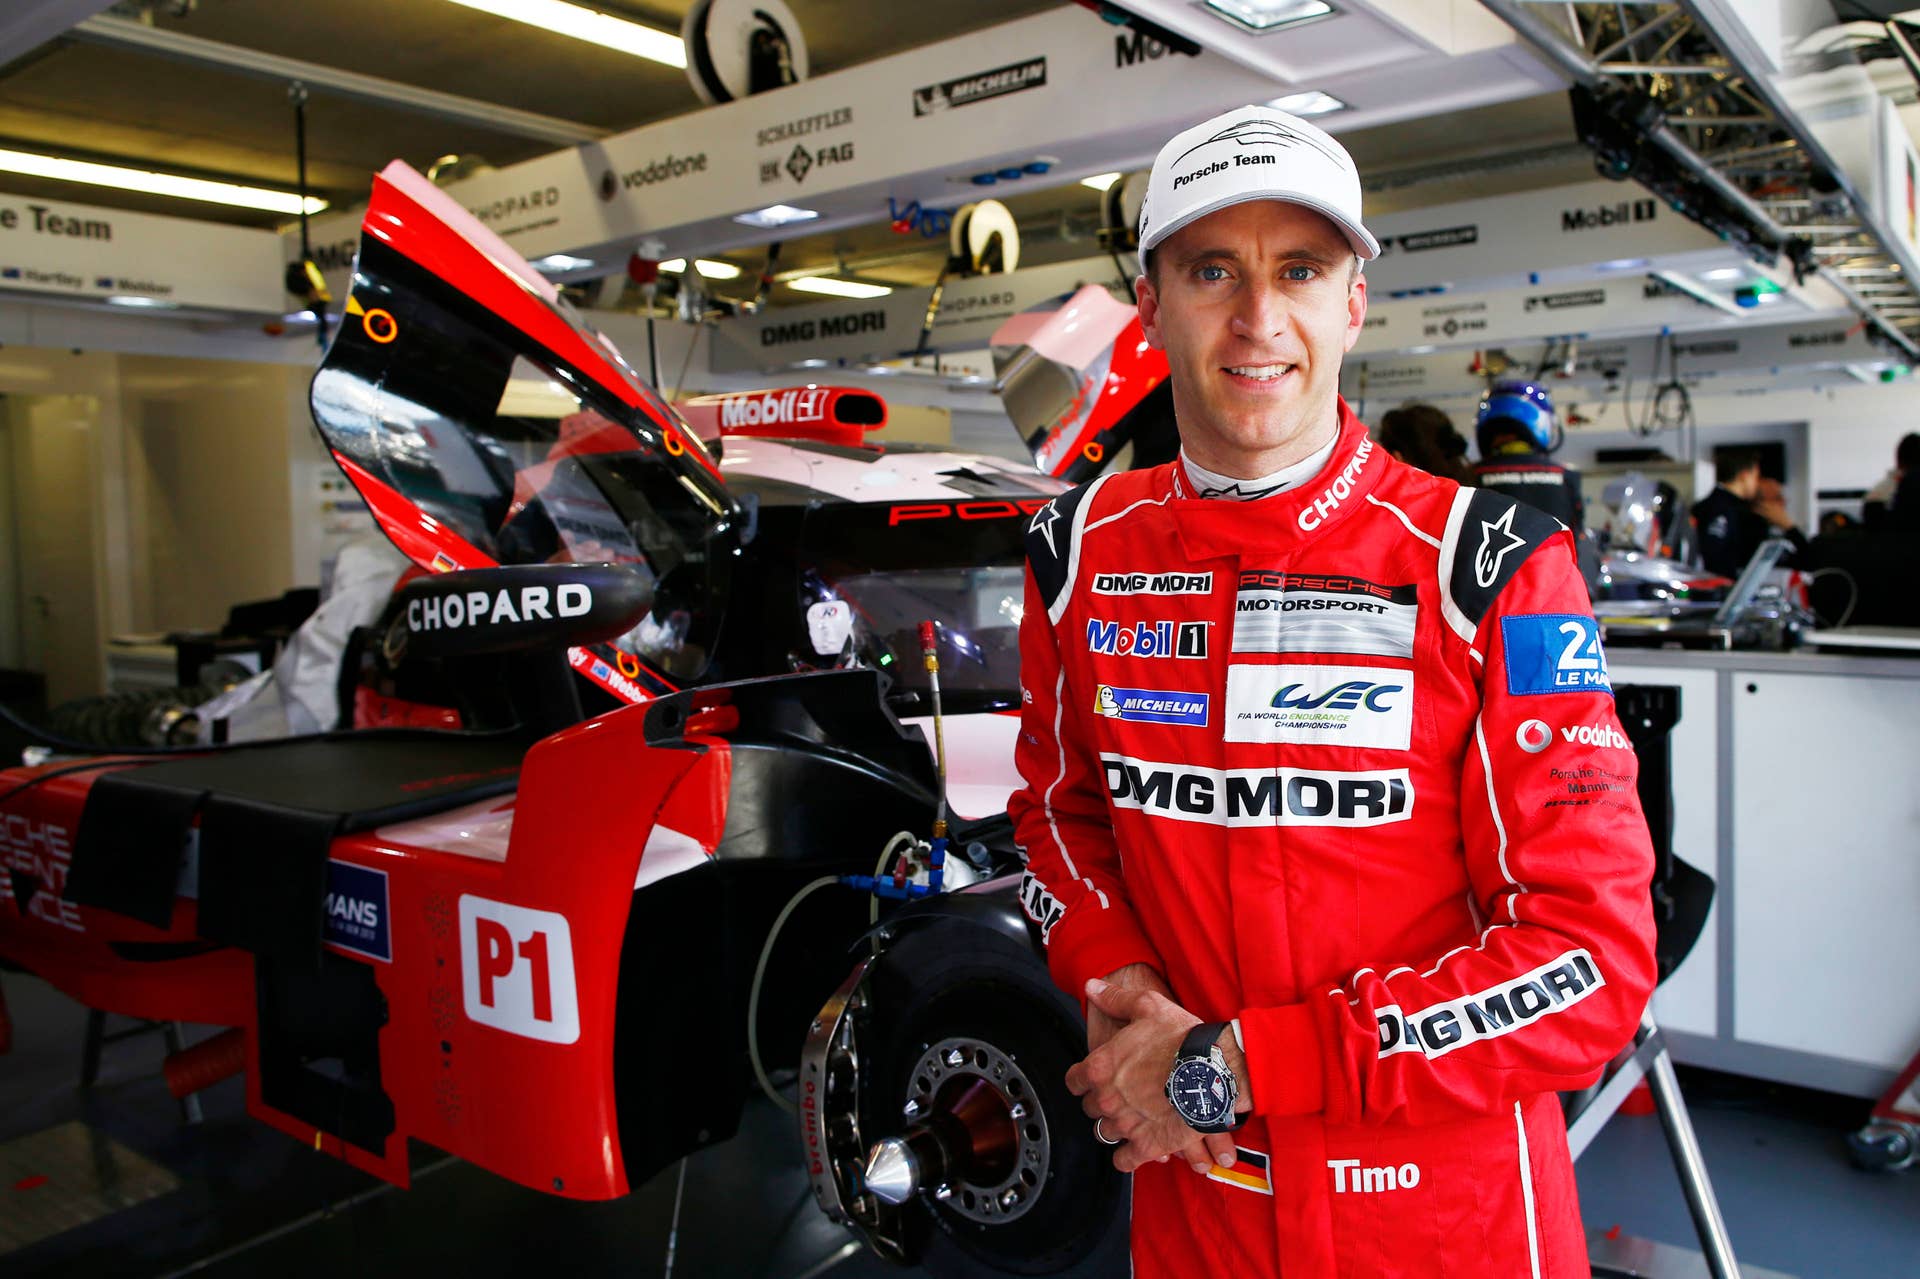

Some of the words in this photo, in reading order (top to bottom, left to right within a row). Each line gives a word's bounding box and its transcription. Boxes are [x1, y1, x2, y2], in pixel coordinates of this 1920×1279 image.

[951, 64, 1044, 97] MICHELIN
[757, 107, 853, 147] SCHAEFFLER
[622, 153, 707, 190] vodafone
[816, 143, 855, 167] FAG
[1173, 161, 1229, 191] Porsche
[1233, 153, 1277, 177] Team
[469, 186, 560, 221] HOPARD
[1562, 204, 1630, 232] Mobil
[28, 205, 112, 241] Team
[761, 318, 815, 346] DMG
[820, 311, 887, 338] MORI
[722, 390, 799, 428] Mobil
[1096, 574, 1148, 592] DMG
[1150, 574, 1211, 592] MORI
[1239, 573, 1393, 599] PORSCHE
[407, 583, 593, 632] CHOPARD
[1237, 598, 1389, 615] MOTORSPORT
[1087, 618, 1173, 657] Mobil
[1269, 680, 1404, 713] WEC
[1555, 671, 1581, 686] LE
[1584, 671, 1613, 691] MA
[1123, 698, 1205, 714] MICHELIN
[1237, 712, 1252, 720] FIA
[1254, 712, 1288, 720] WORLD
[1288, 713, 1351, 722] ENDURANCE
[1274, 720, 1347, 730] CHAMPIONSHIP
[1102, 759, 1215, 815] DMG
[1226, 775, 1407, 818] MORI
[1549, 768, 1594, 780] Porsche
[0, 811, 72, 859] CHE
[475, 915, 553, 1023] P1
[1464, 955, 1597, 1034] MORI
[801, 1080, 824, 1175] brembo
[1327, 1159, 1420, 1193] Timo
